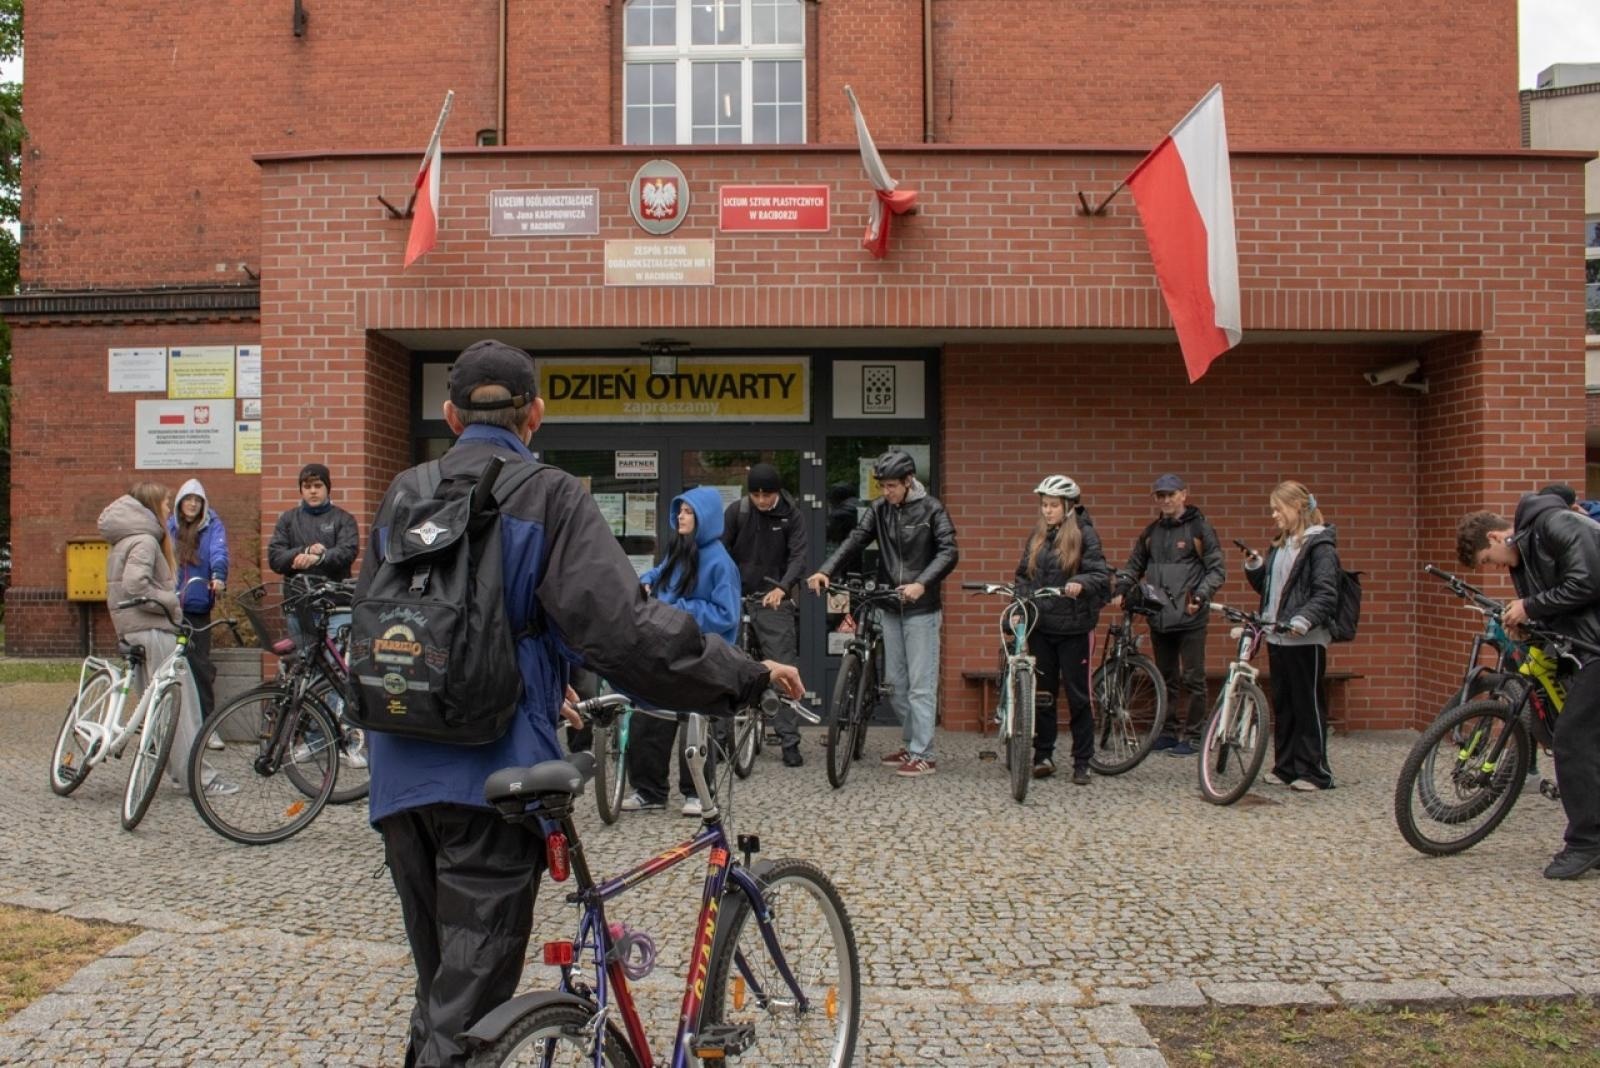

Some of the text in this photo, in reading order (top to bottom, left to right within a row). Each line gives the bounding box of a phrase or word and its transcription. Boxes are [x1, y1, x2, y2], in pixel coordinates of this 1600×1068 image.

[499, 196, 525, 207] LICEUM
[723, 196, 824, 207] LICEUM SZTUK PLASTYCZNYCH
[749, 210, 798, 220] W RACIBORZU
[548, 368, 796, 400] DZIEŃ OTWARTY
[866, 394, 891, 405] LSP
[623, 400, 720, 416] zapraszamy
[618, 459, 655, 468] PARTNER
[694, 896, 719, 1000] GIANT
